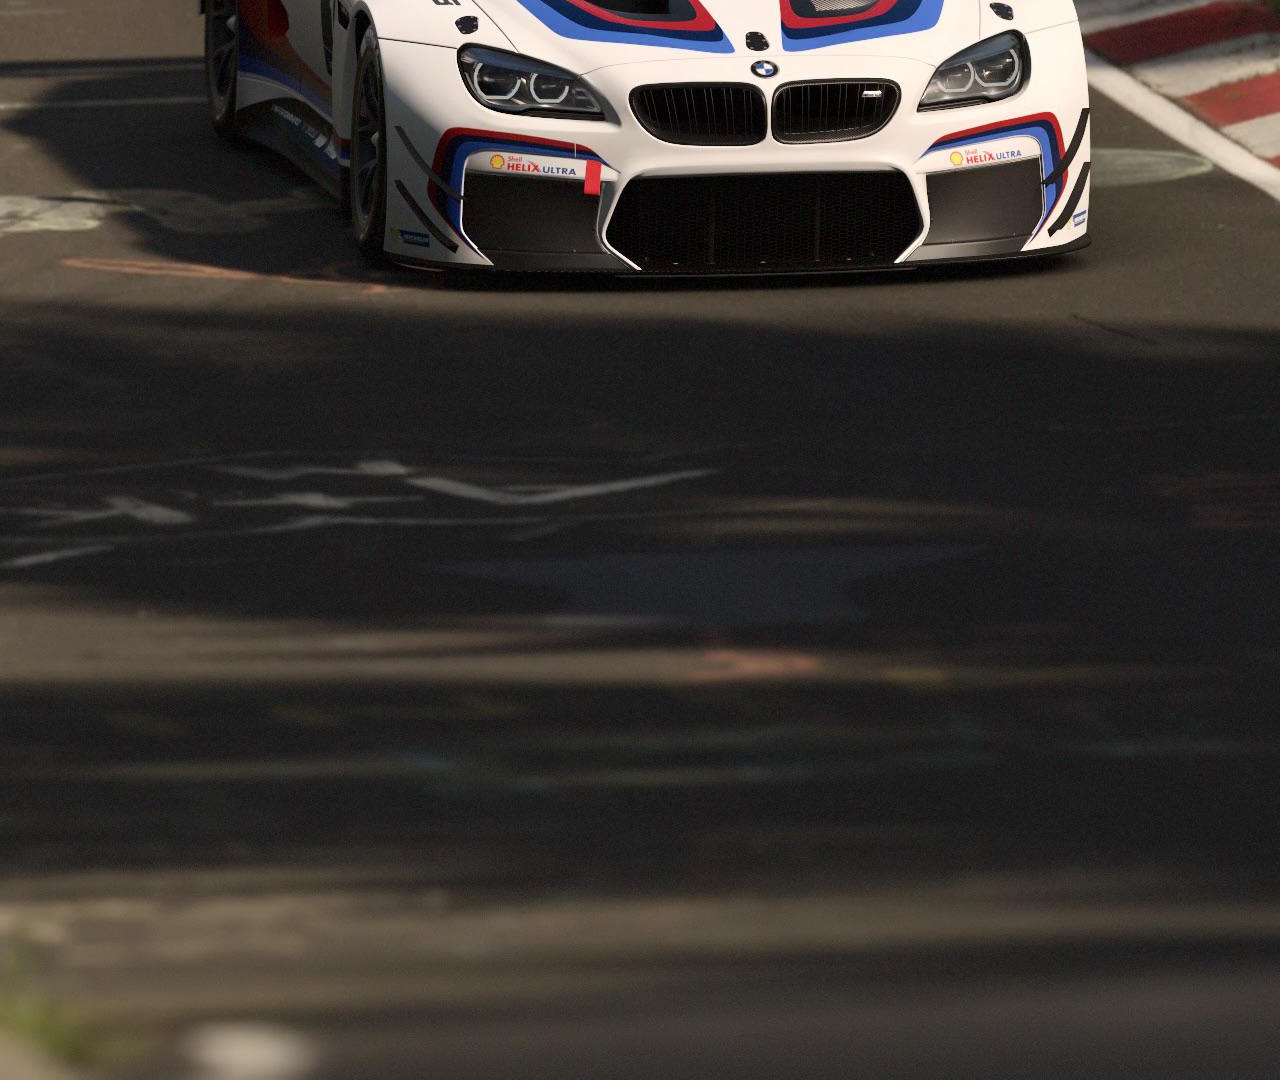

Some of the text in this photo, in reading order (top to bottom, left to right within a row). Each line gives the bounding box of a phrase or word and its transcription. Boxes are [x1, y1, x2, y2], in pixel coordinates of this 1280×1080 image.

[966, 149, 1022, 164] HELIX ULTRA
[506, 161, 577, 176] HELIX ULTRA
